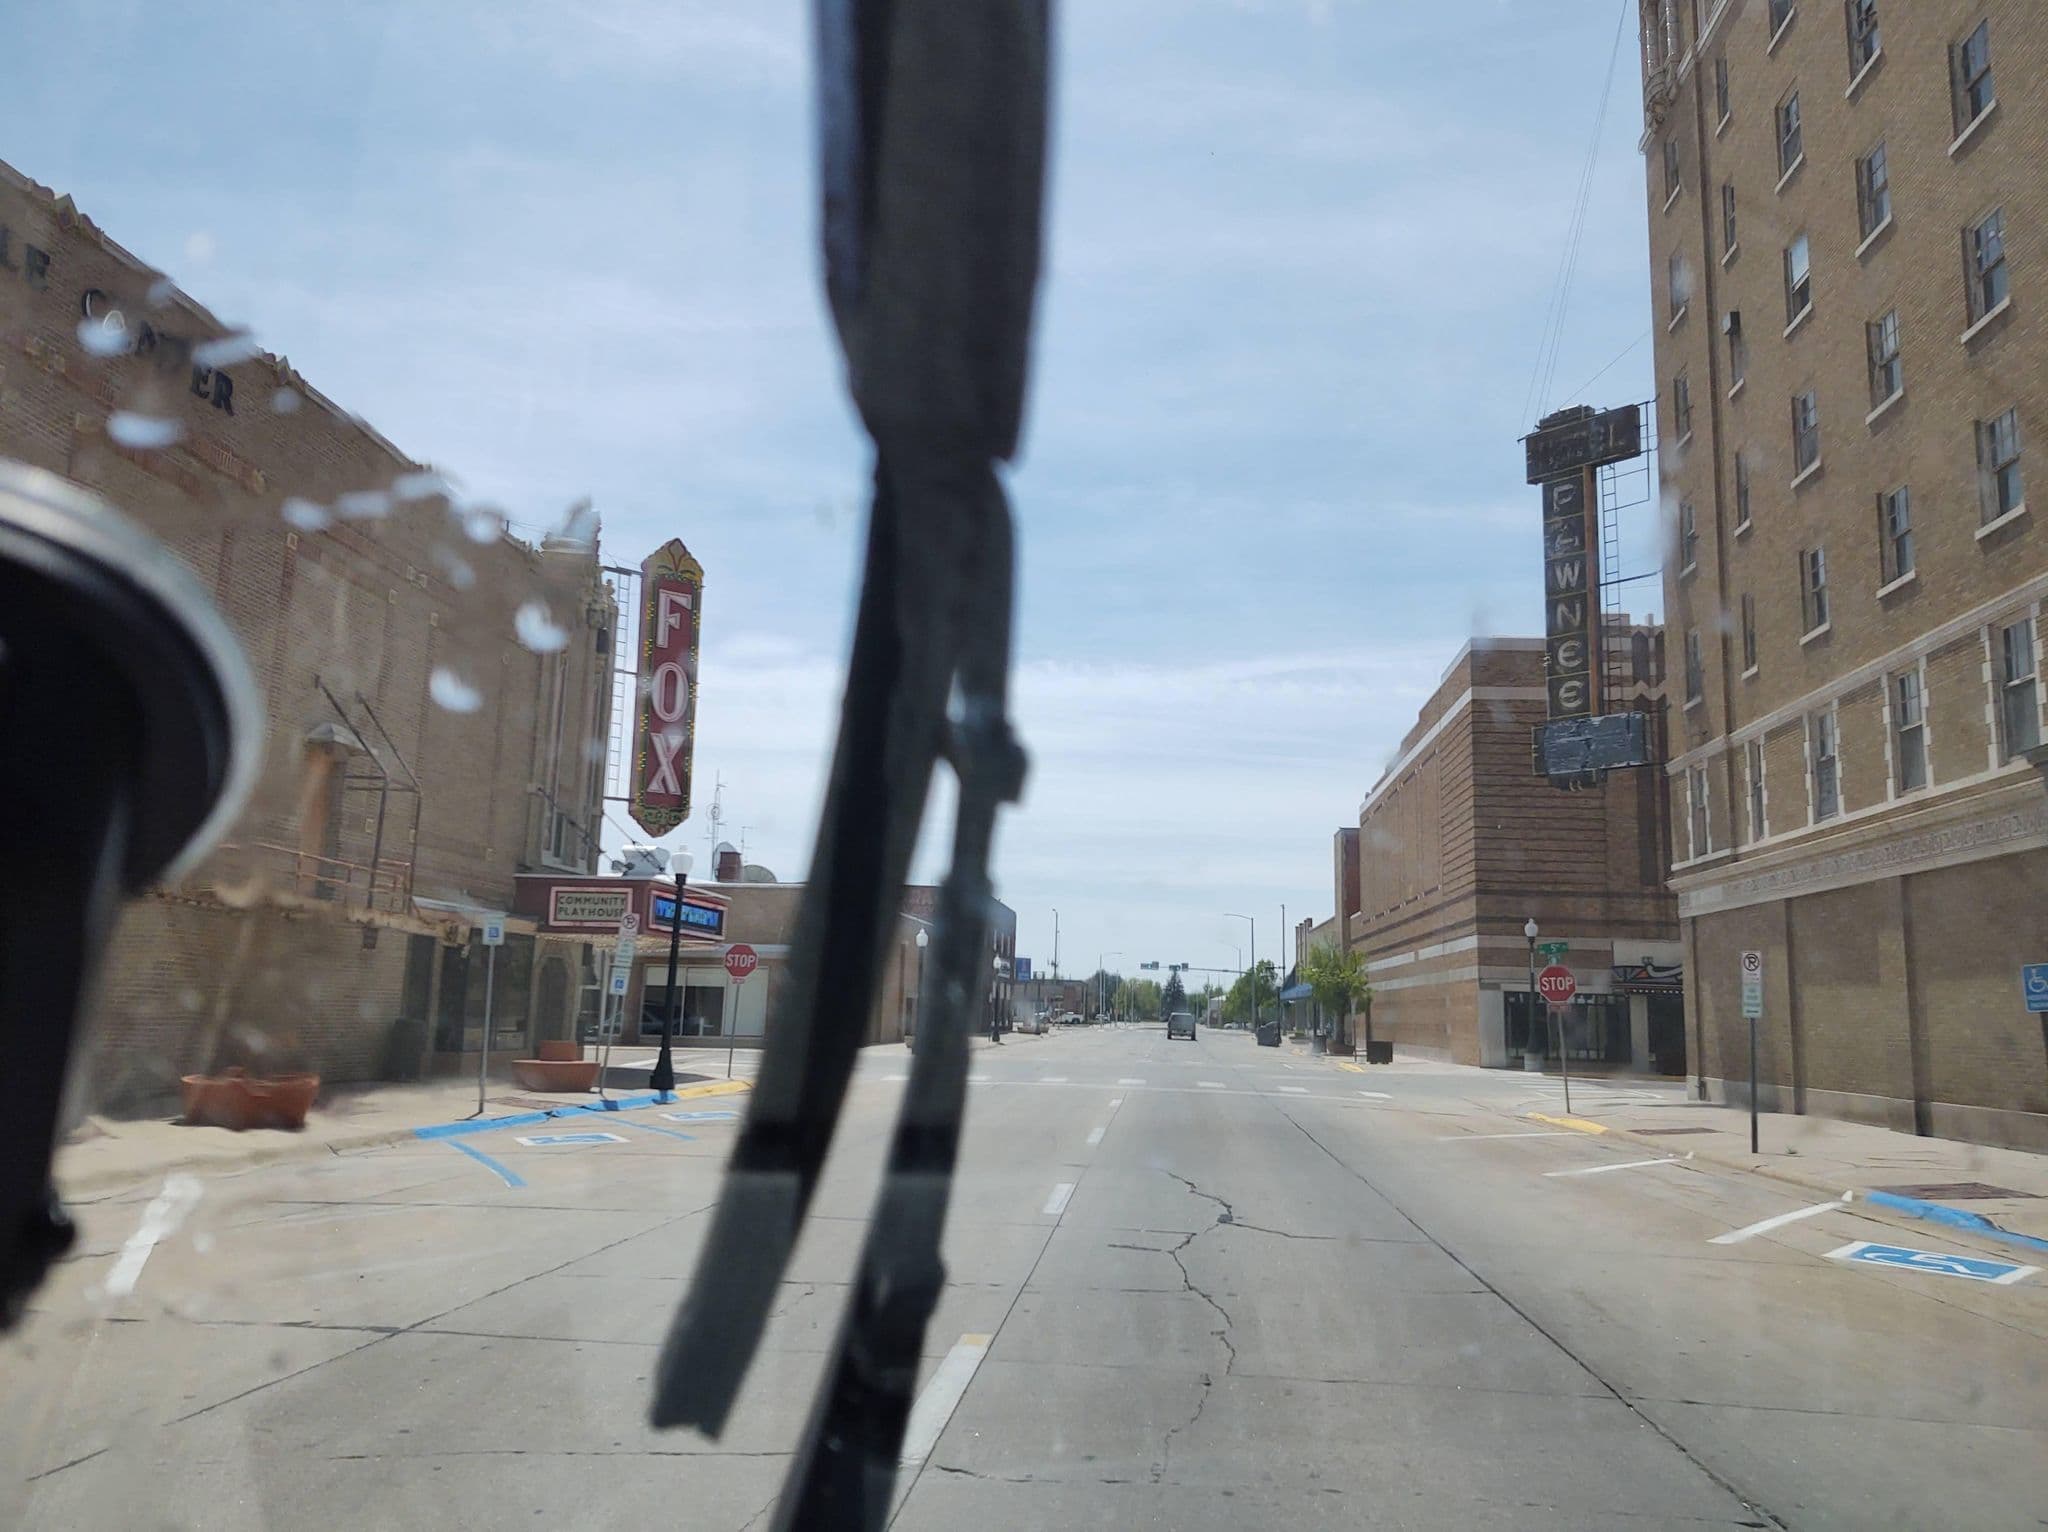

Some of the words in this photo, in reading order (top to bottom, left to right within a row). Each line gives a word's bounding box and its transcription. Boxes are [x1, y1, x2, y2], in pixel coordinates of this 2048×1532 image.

[1553, 483, 1584, 708] PAWNEE
[647, 588, 693, 796] FOX
[558, 896, 626, 905] COMMUNITY
[558, 907, 625, 918] PLAYHOUSE
[726, 953, 756, 967] STOP
[1541, 977, 1574, 991] STOP
